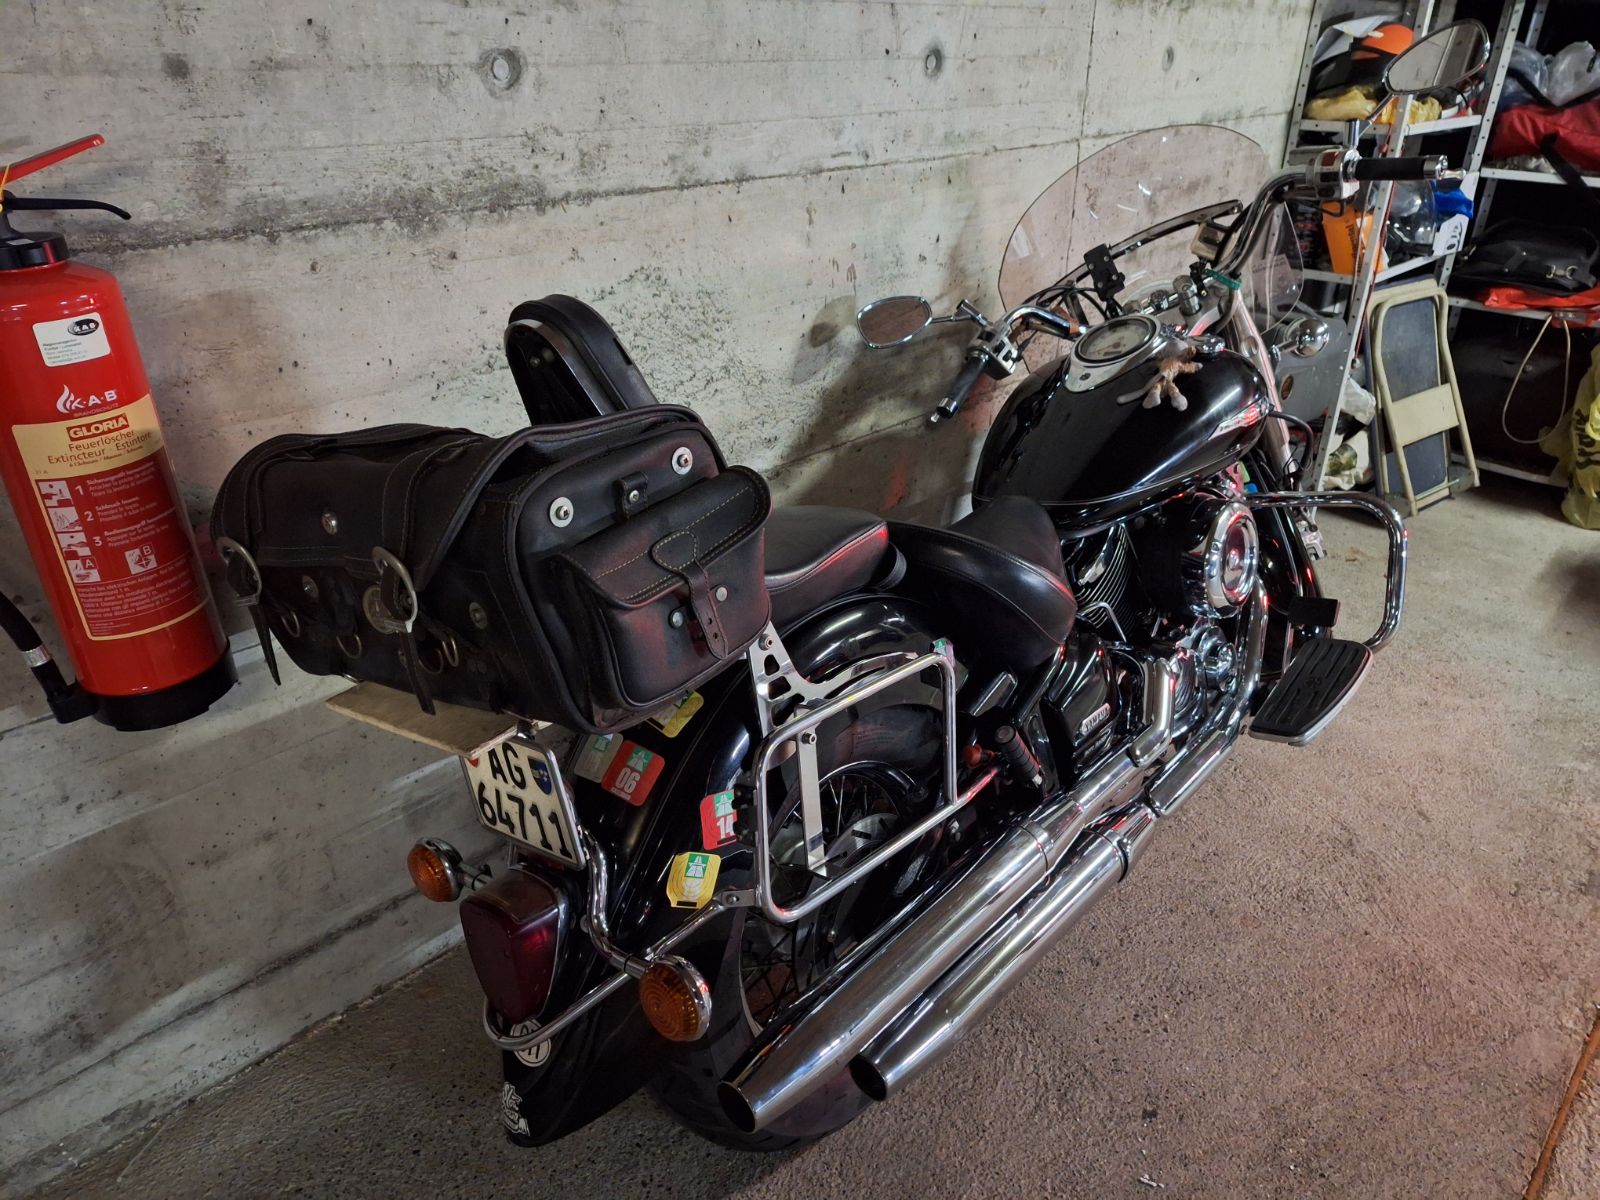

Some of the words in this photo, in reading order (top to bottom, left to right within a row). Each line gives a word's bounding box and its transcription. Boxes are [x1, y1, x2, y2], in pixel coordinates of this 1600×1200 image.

[69, 416, 128, 438] GLORIA
[68, 430, 135, 453] Feuerlöscher
[48, 448, 106, 464] Extincteur
[75, 485, 84, 495] 1
[84, 510, 94, 521] 2
[93, 536, 102, 547] 3
[142, 545, 152, 555] B
[85, 559, 95, 569] A
[487, 742, 527, 790] AG
[615, 767, 641, 794] 06
[477, 782, 573, 860] 64711
